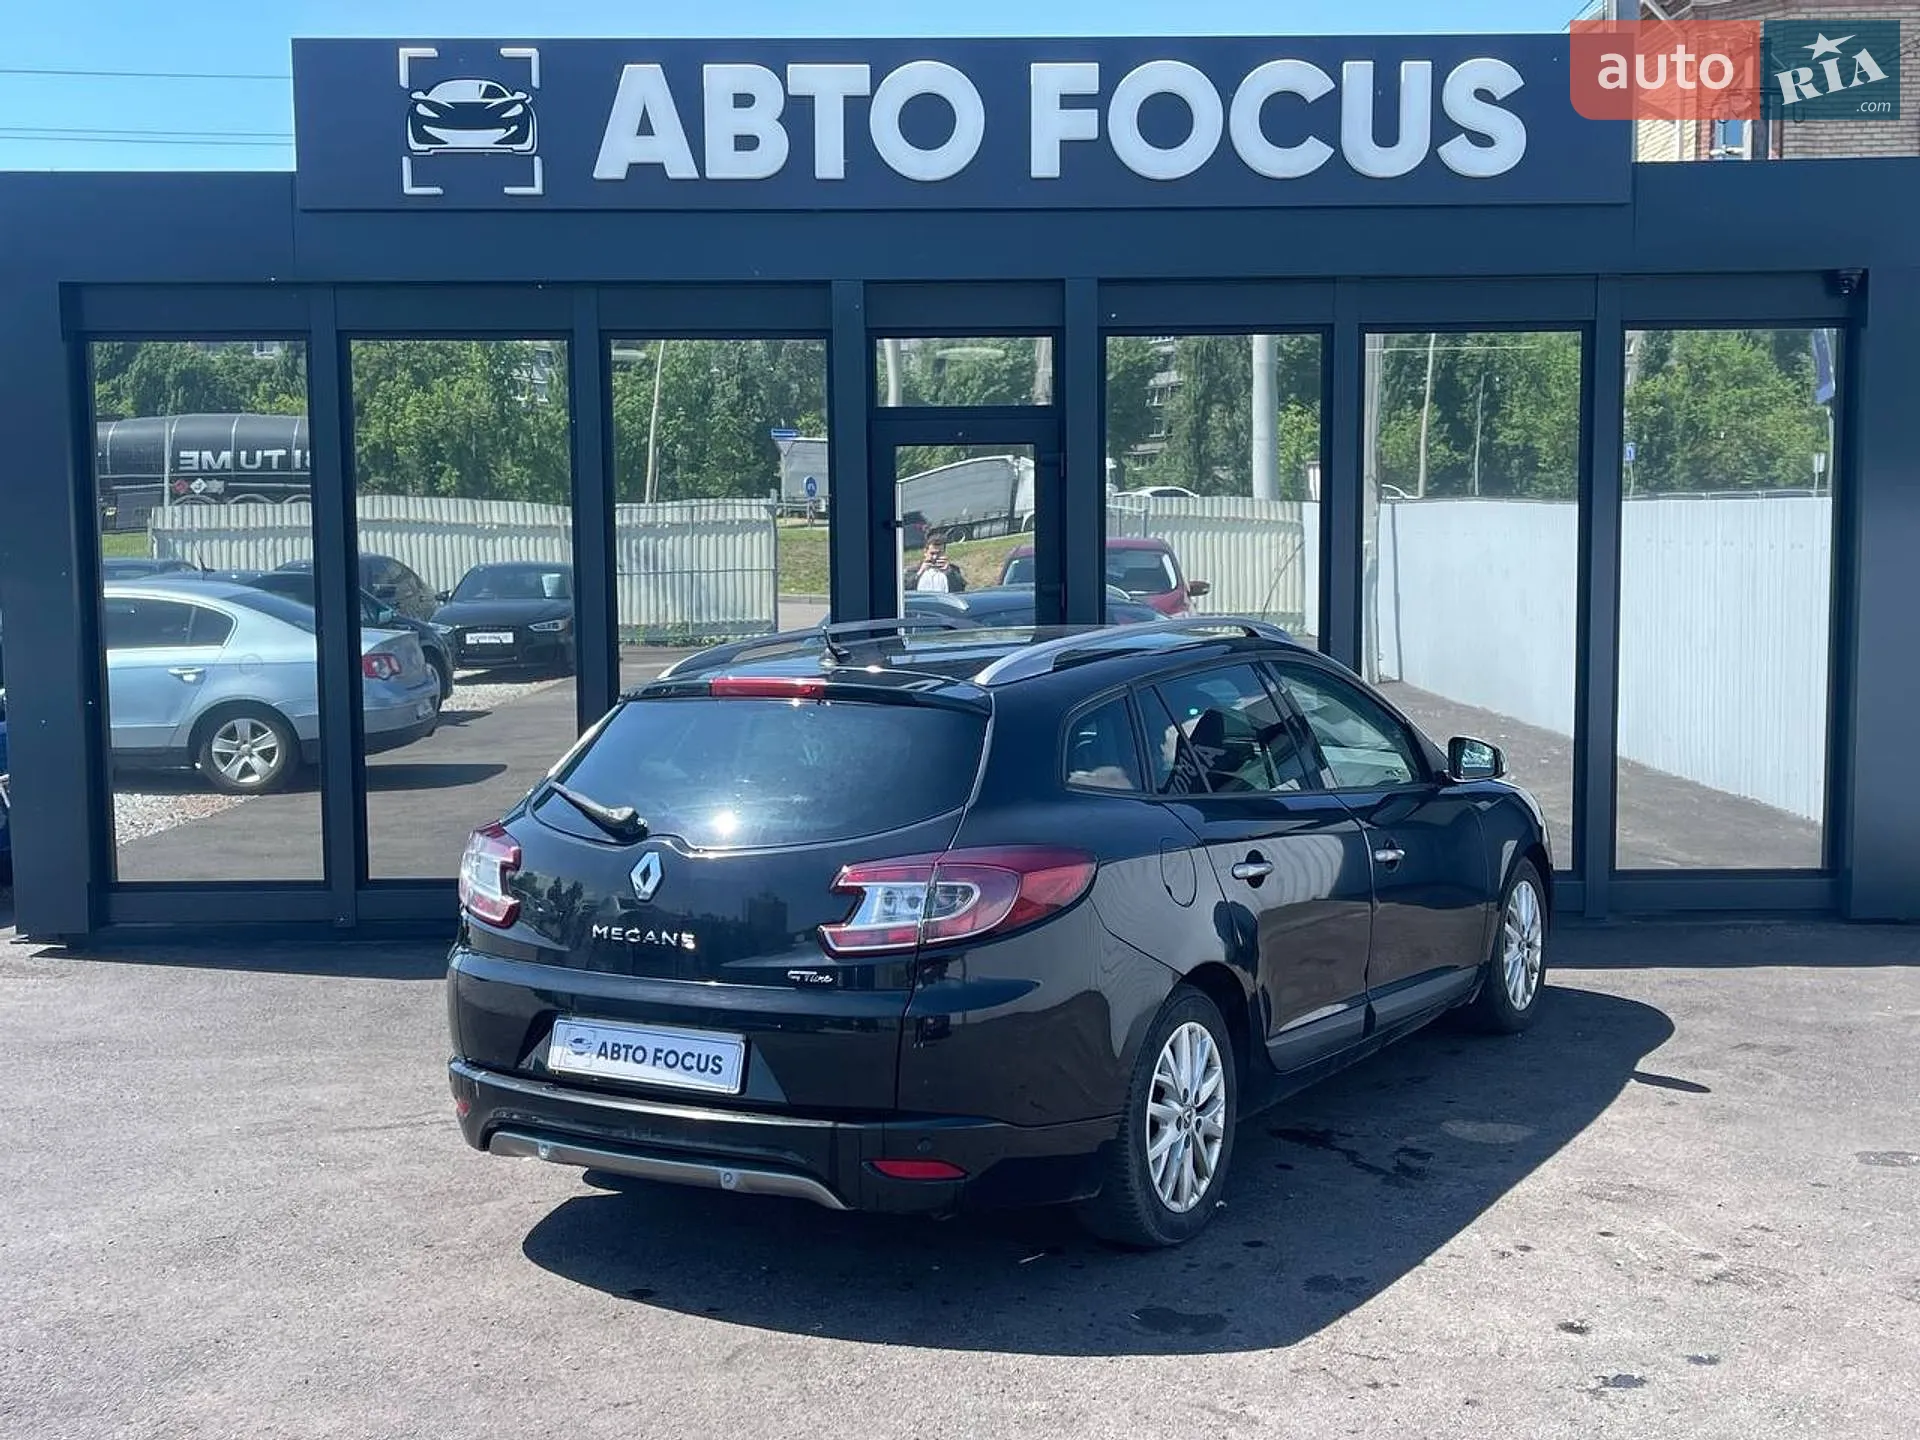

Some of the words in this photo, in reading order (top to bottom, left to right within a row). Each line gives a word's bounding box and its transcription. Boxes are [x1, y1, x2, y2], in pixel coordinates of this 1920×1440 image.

[592, 60, 986, 182] АВТО
[1029, 58, 1528, 181] FOCUS
[596, 1041, 648, 1065] АВТО
[652, 1047, 724, 1076] FOCUS
